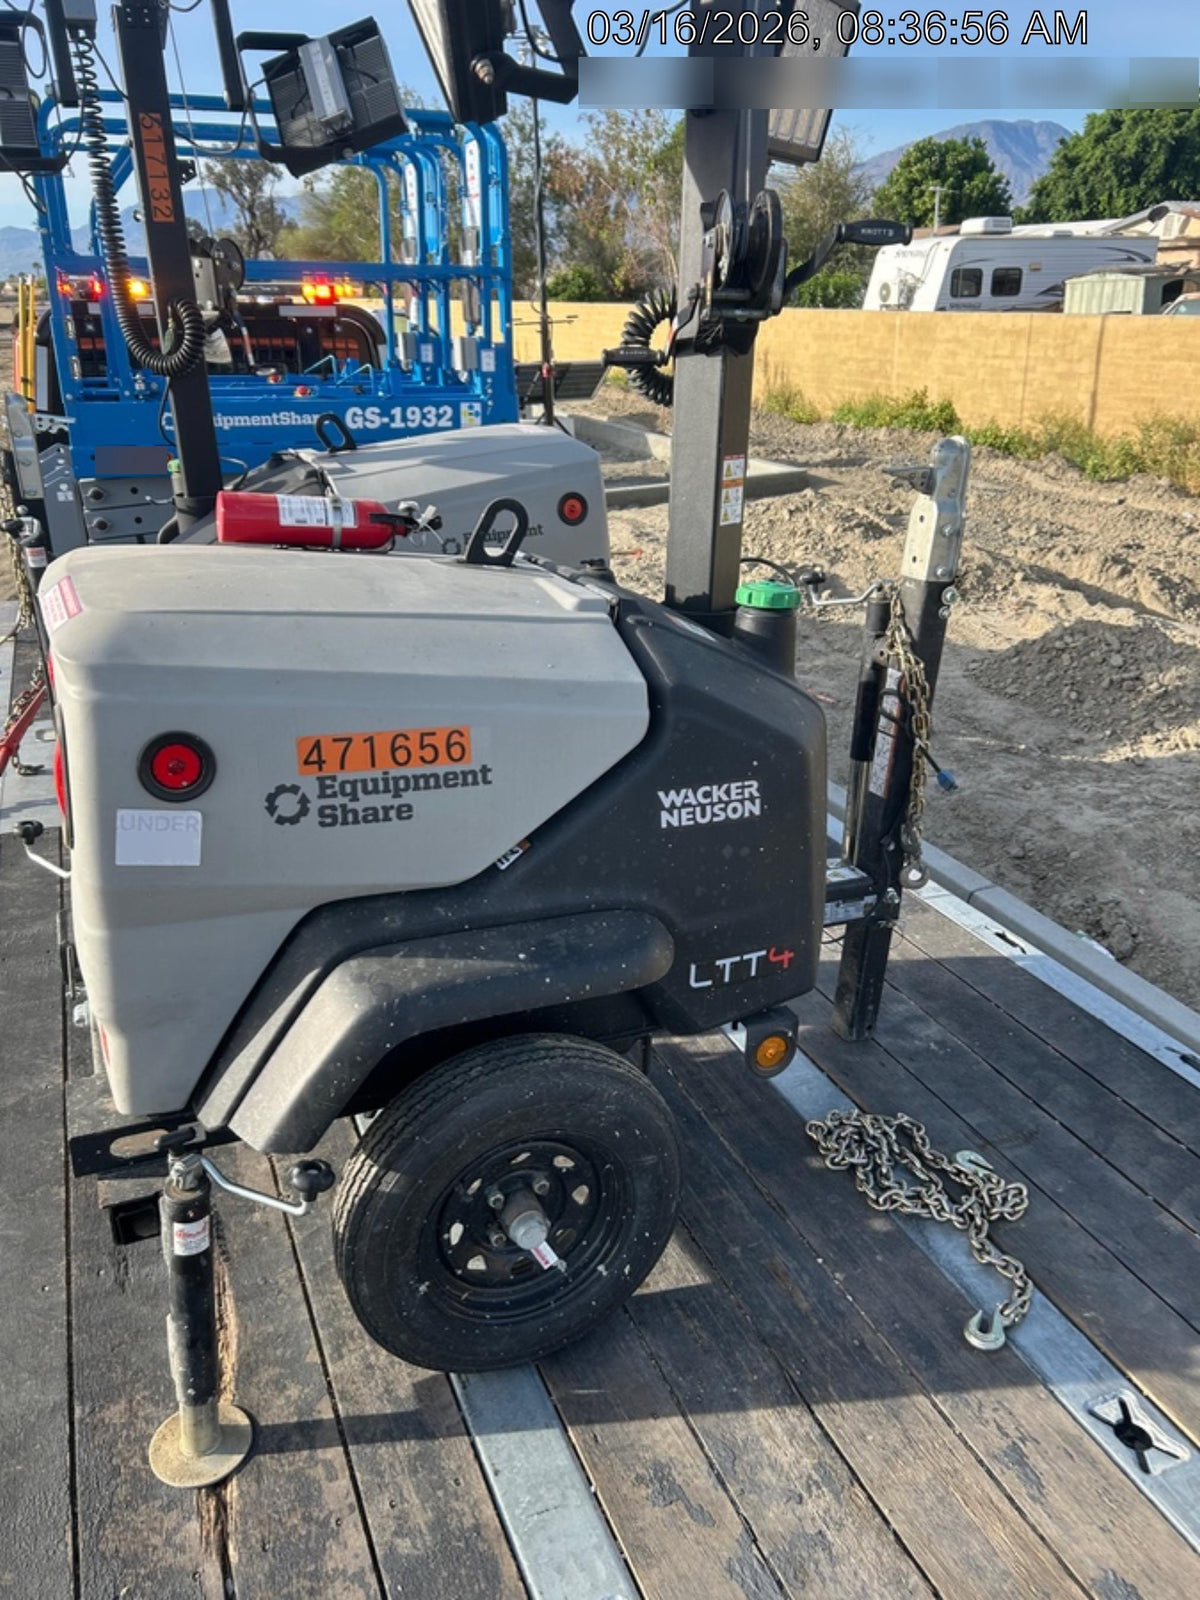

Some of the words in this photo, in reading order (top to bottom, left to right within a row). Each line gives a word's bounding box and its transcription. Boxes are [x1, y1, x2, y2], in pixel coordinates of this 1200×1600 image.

[345, 405, 454, 429] GS-1932
[303, 729, 467, 772] 471656
[316, 764, 493, 802] Equipment
[657, 780, 760, 809] WACKER
[121, 813, 199, 832] UNDER
[317, 802, 414, 828] Share
[660, 798, 761, 829] NEUSON
[689, 946, 795, 989] LTT4
